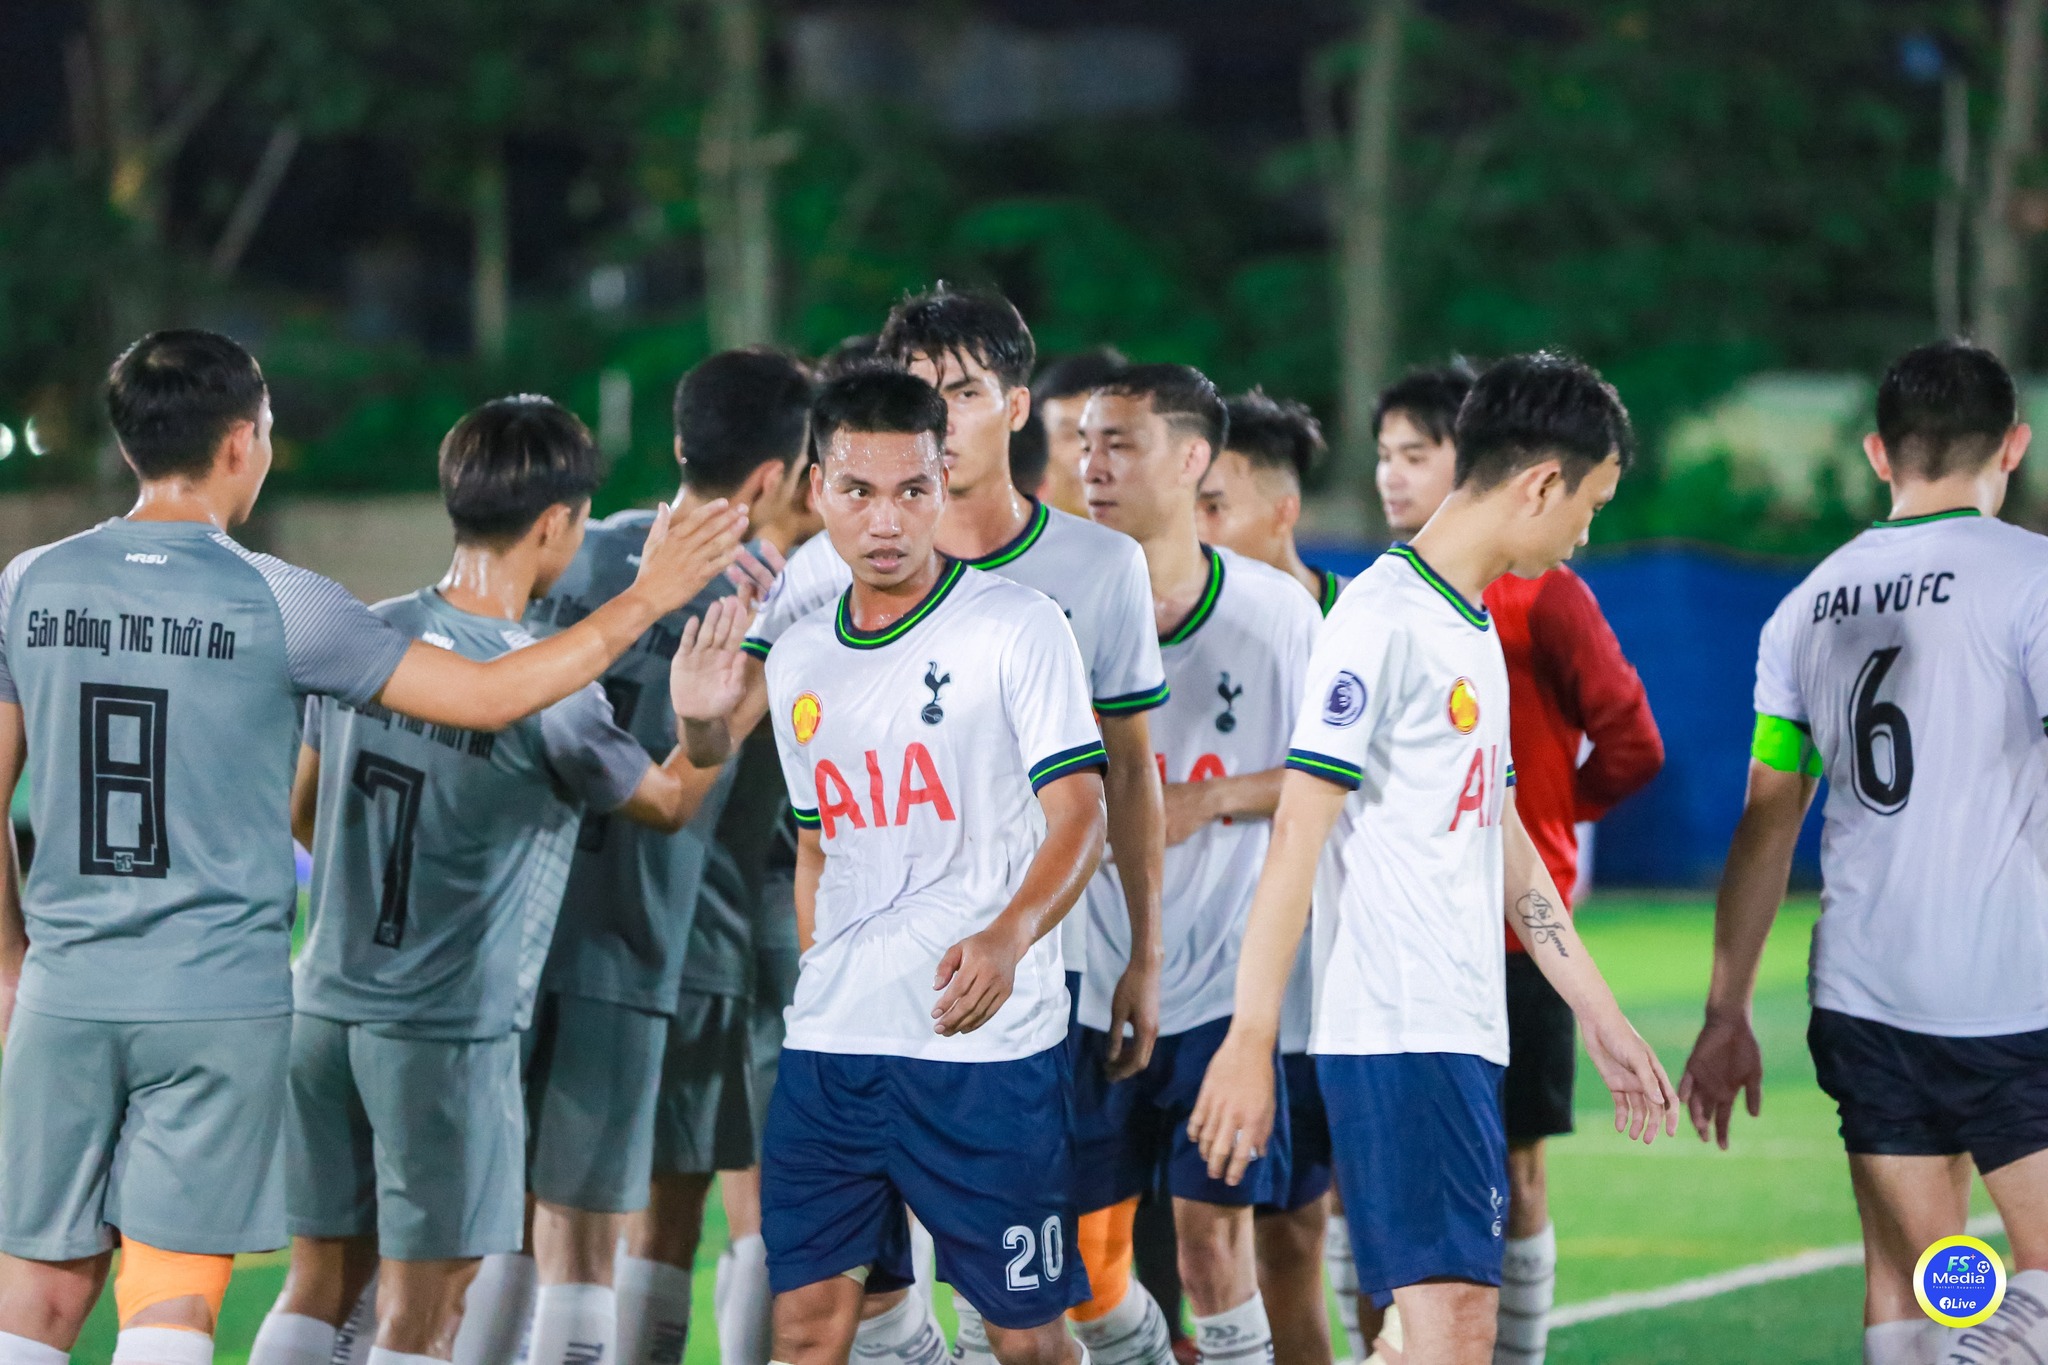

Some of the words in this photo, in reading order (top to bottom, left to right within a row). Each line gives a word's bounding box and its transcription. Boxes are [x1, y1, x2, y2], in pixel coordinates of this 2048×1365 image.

[27, 608, 58, 648] Sân
[63, 607, 112, 656] Bóng
[119, 613, 154, 653] TNG
[207, 622, 236, 660] An
[1812, 584, 1862, 625] ĐẠI
[1874, 573, 1913, 615] VŨ
[1917, 571, 1956, 607] FC
[80, 682, 170, 879] 8
[1849, 645, 1914, 816] 6
[814, 741, 957, 841] AIA
[352, 749, 426, 949] 7
[1002, 1215, 1064, 1291] 20
